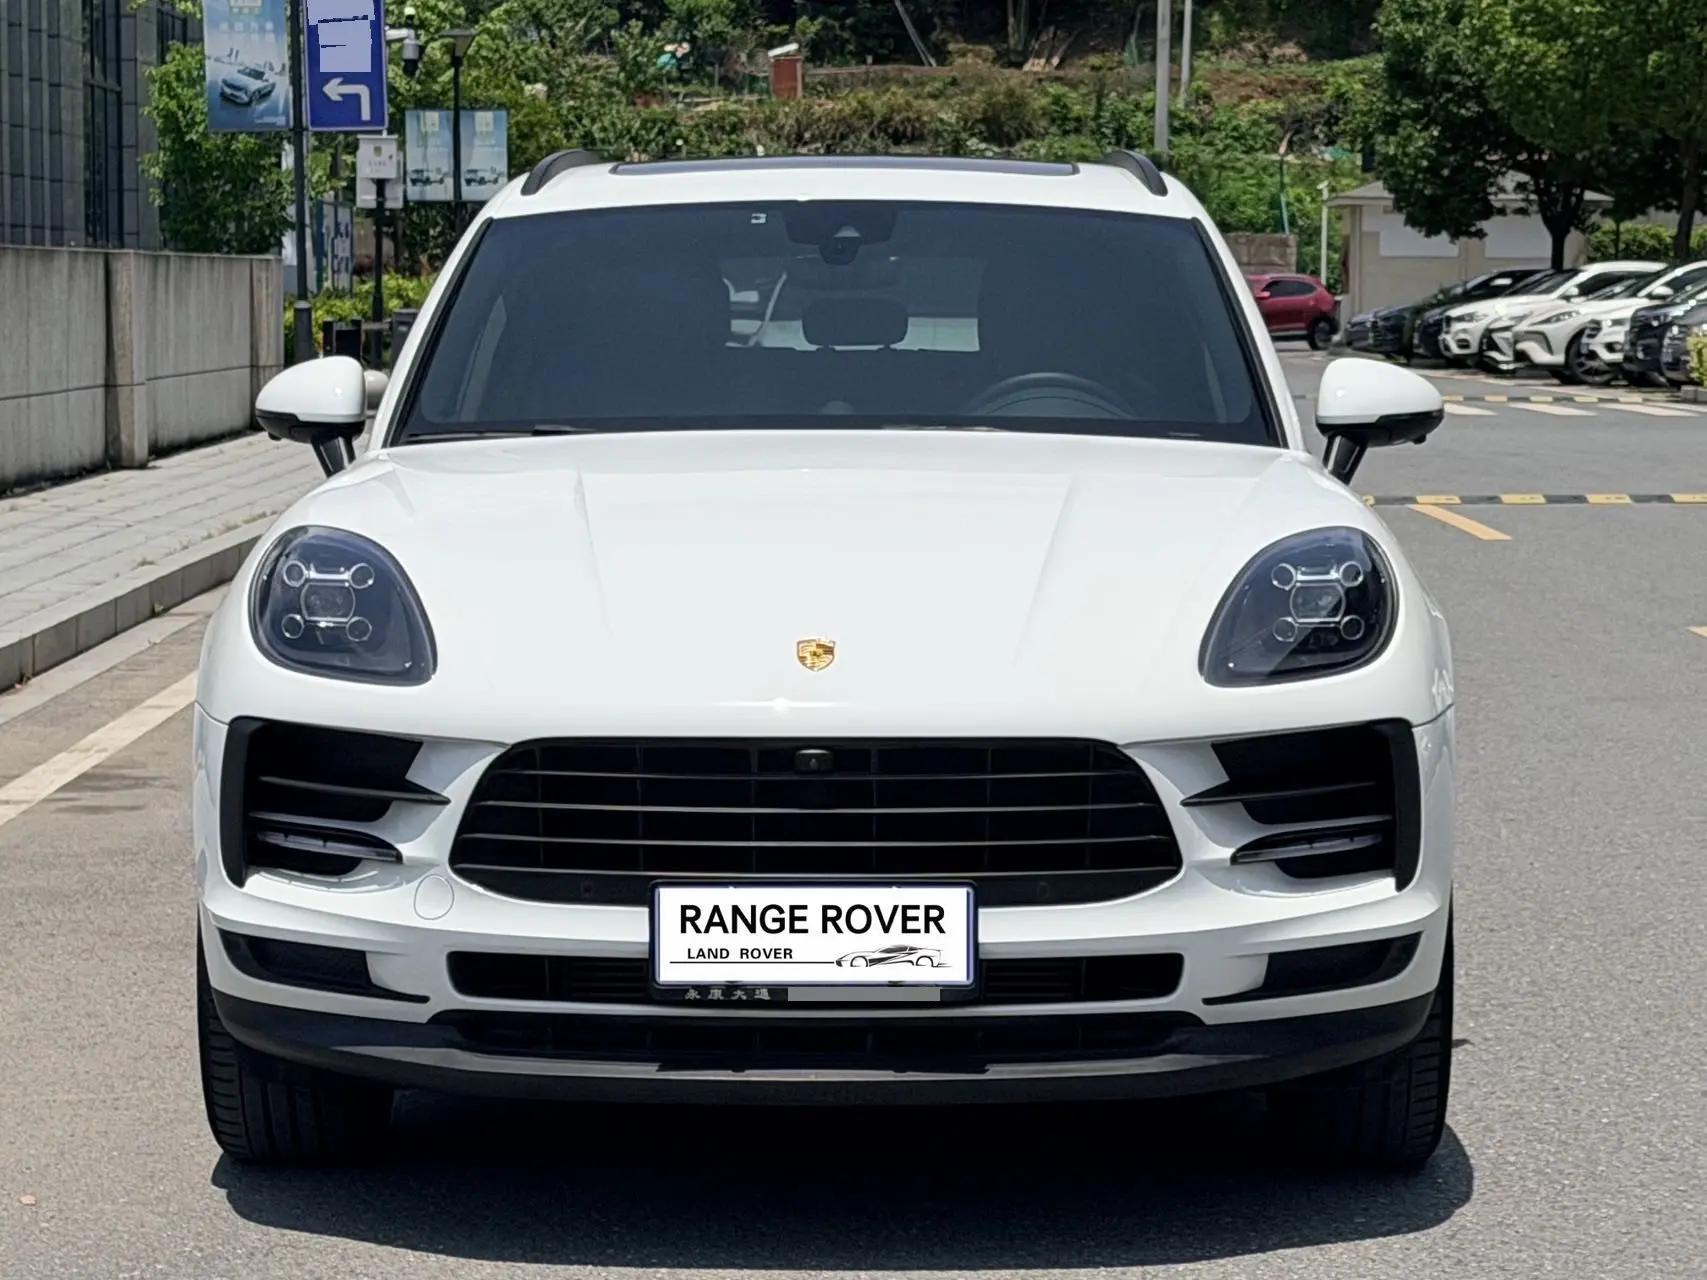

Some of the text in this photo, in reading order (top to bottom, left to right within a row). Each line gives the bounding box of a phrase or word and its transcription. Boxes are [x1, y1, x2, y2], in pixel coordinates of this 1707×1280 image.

[681, 904, 945, 934] RANGE ROVER
[688, 948, 792, 959] LAND ROVER
